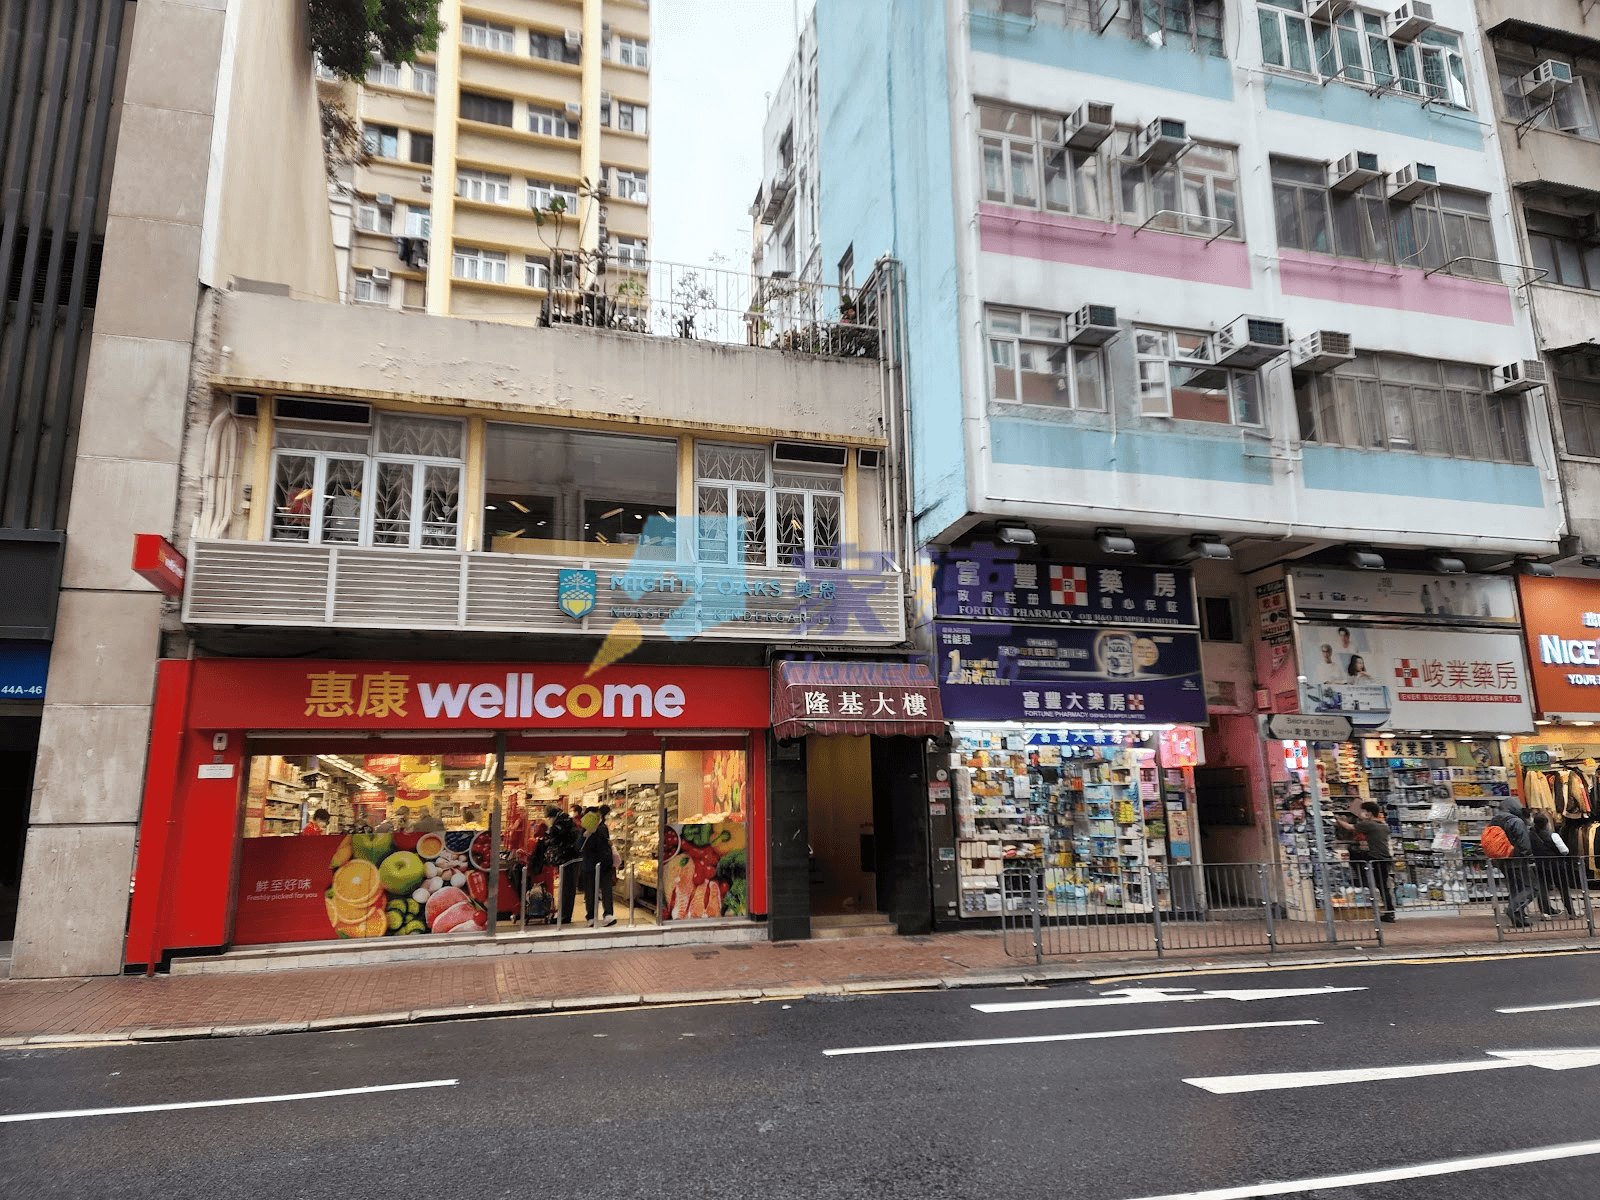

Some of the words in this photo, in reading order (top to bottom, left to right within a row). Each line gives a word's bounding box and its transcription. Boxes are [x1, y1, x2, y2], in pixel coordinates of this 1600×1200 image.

[610, 574, 708, 593] MIGHTY
[717, 578, 783, 597] OAKS
[956, 560, 1039, 589] 富豐
[1098, 568, 1177, 598] 藥房
[610, 606, 687, 619] NURSERY
[696, 609, 704, 620] &
[715, 608, 836, 625] KINDERGARTEN
[958, 605, 1010, 616] FORTUNE
[1013, 608, 1074, 619] PHARMACY
[1114, 615, 1145, 623] BUMPER
[1147, 617, 1179, 625] LIMITED
[1540, 635, 1599, 665] NICE
[1421, 659, 1518, 689] 峻業藥房
[1568, 674, 1596, 685] YOUR
[1, 685, 43, 695] 44A-46
[304, 671, 410, 718] 惠康
[418, 672, 686, 719] wellcome
[804, 691, 928, 716] 隆基大樓
[1022, 691, 1126, 711] 富豐大藥房
[255, 879, 312, 892] 鮮至好味
[272, 892, 294, 900] picked
